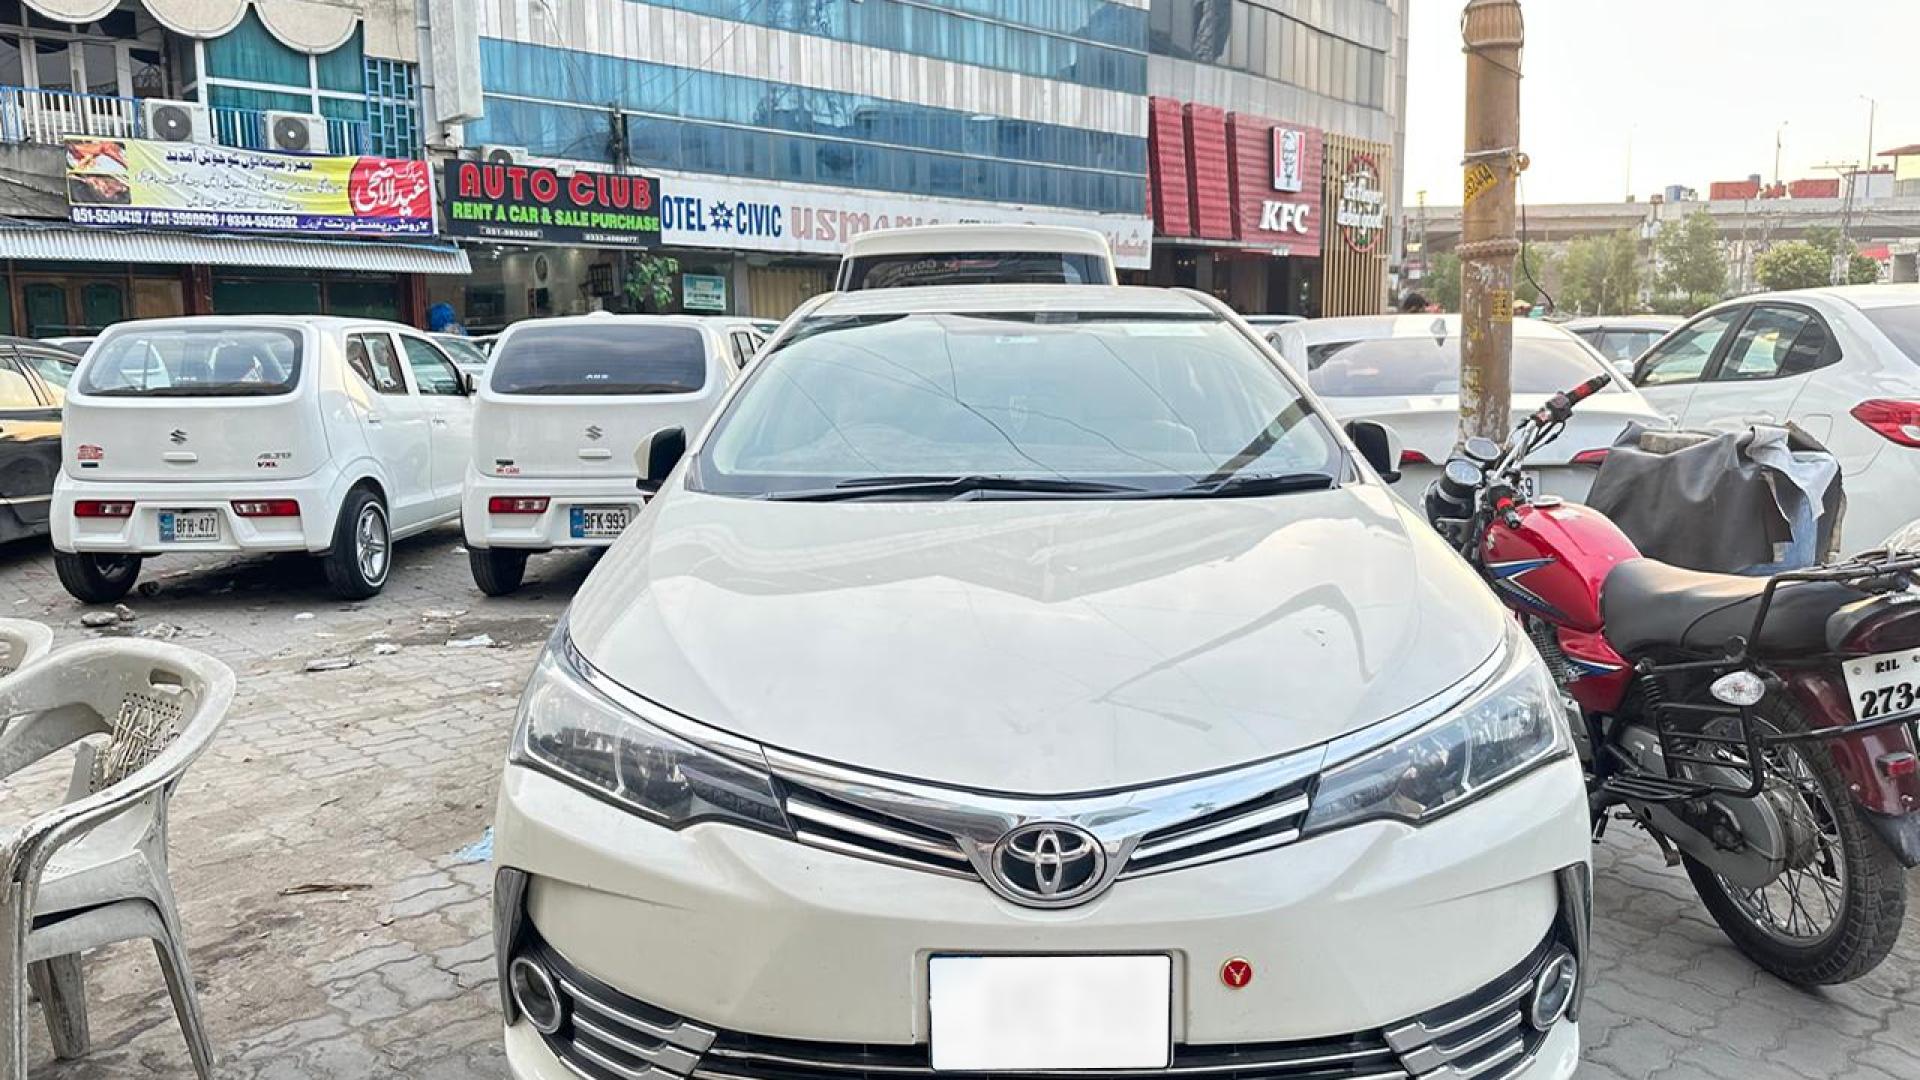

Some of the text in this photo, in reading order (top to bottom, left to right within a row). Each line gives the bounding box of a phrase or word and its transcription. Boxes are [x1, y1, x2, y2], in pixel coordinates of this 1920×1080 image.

[459, 162, 651, 211] AUTO CLUB
[453, 202, 661, 231] RENT A CAR & SALE PURCHASE
[662, 195, 782, 237] OTEL CIVIC
[1259, 200, 1310, 234] KFC
